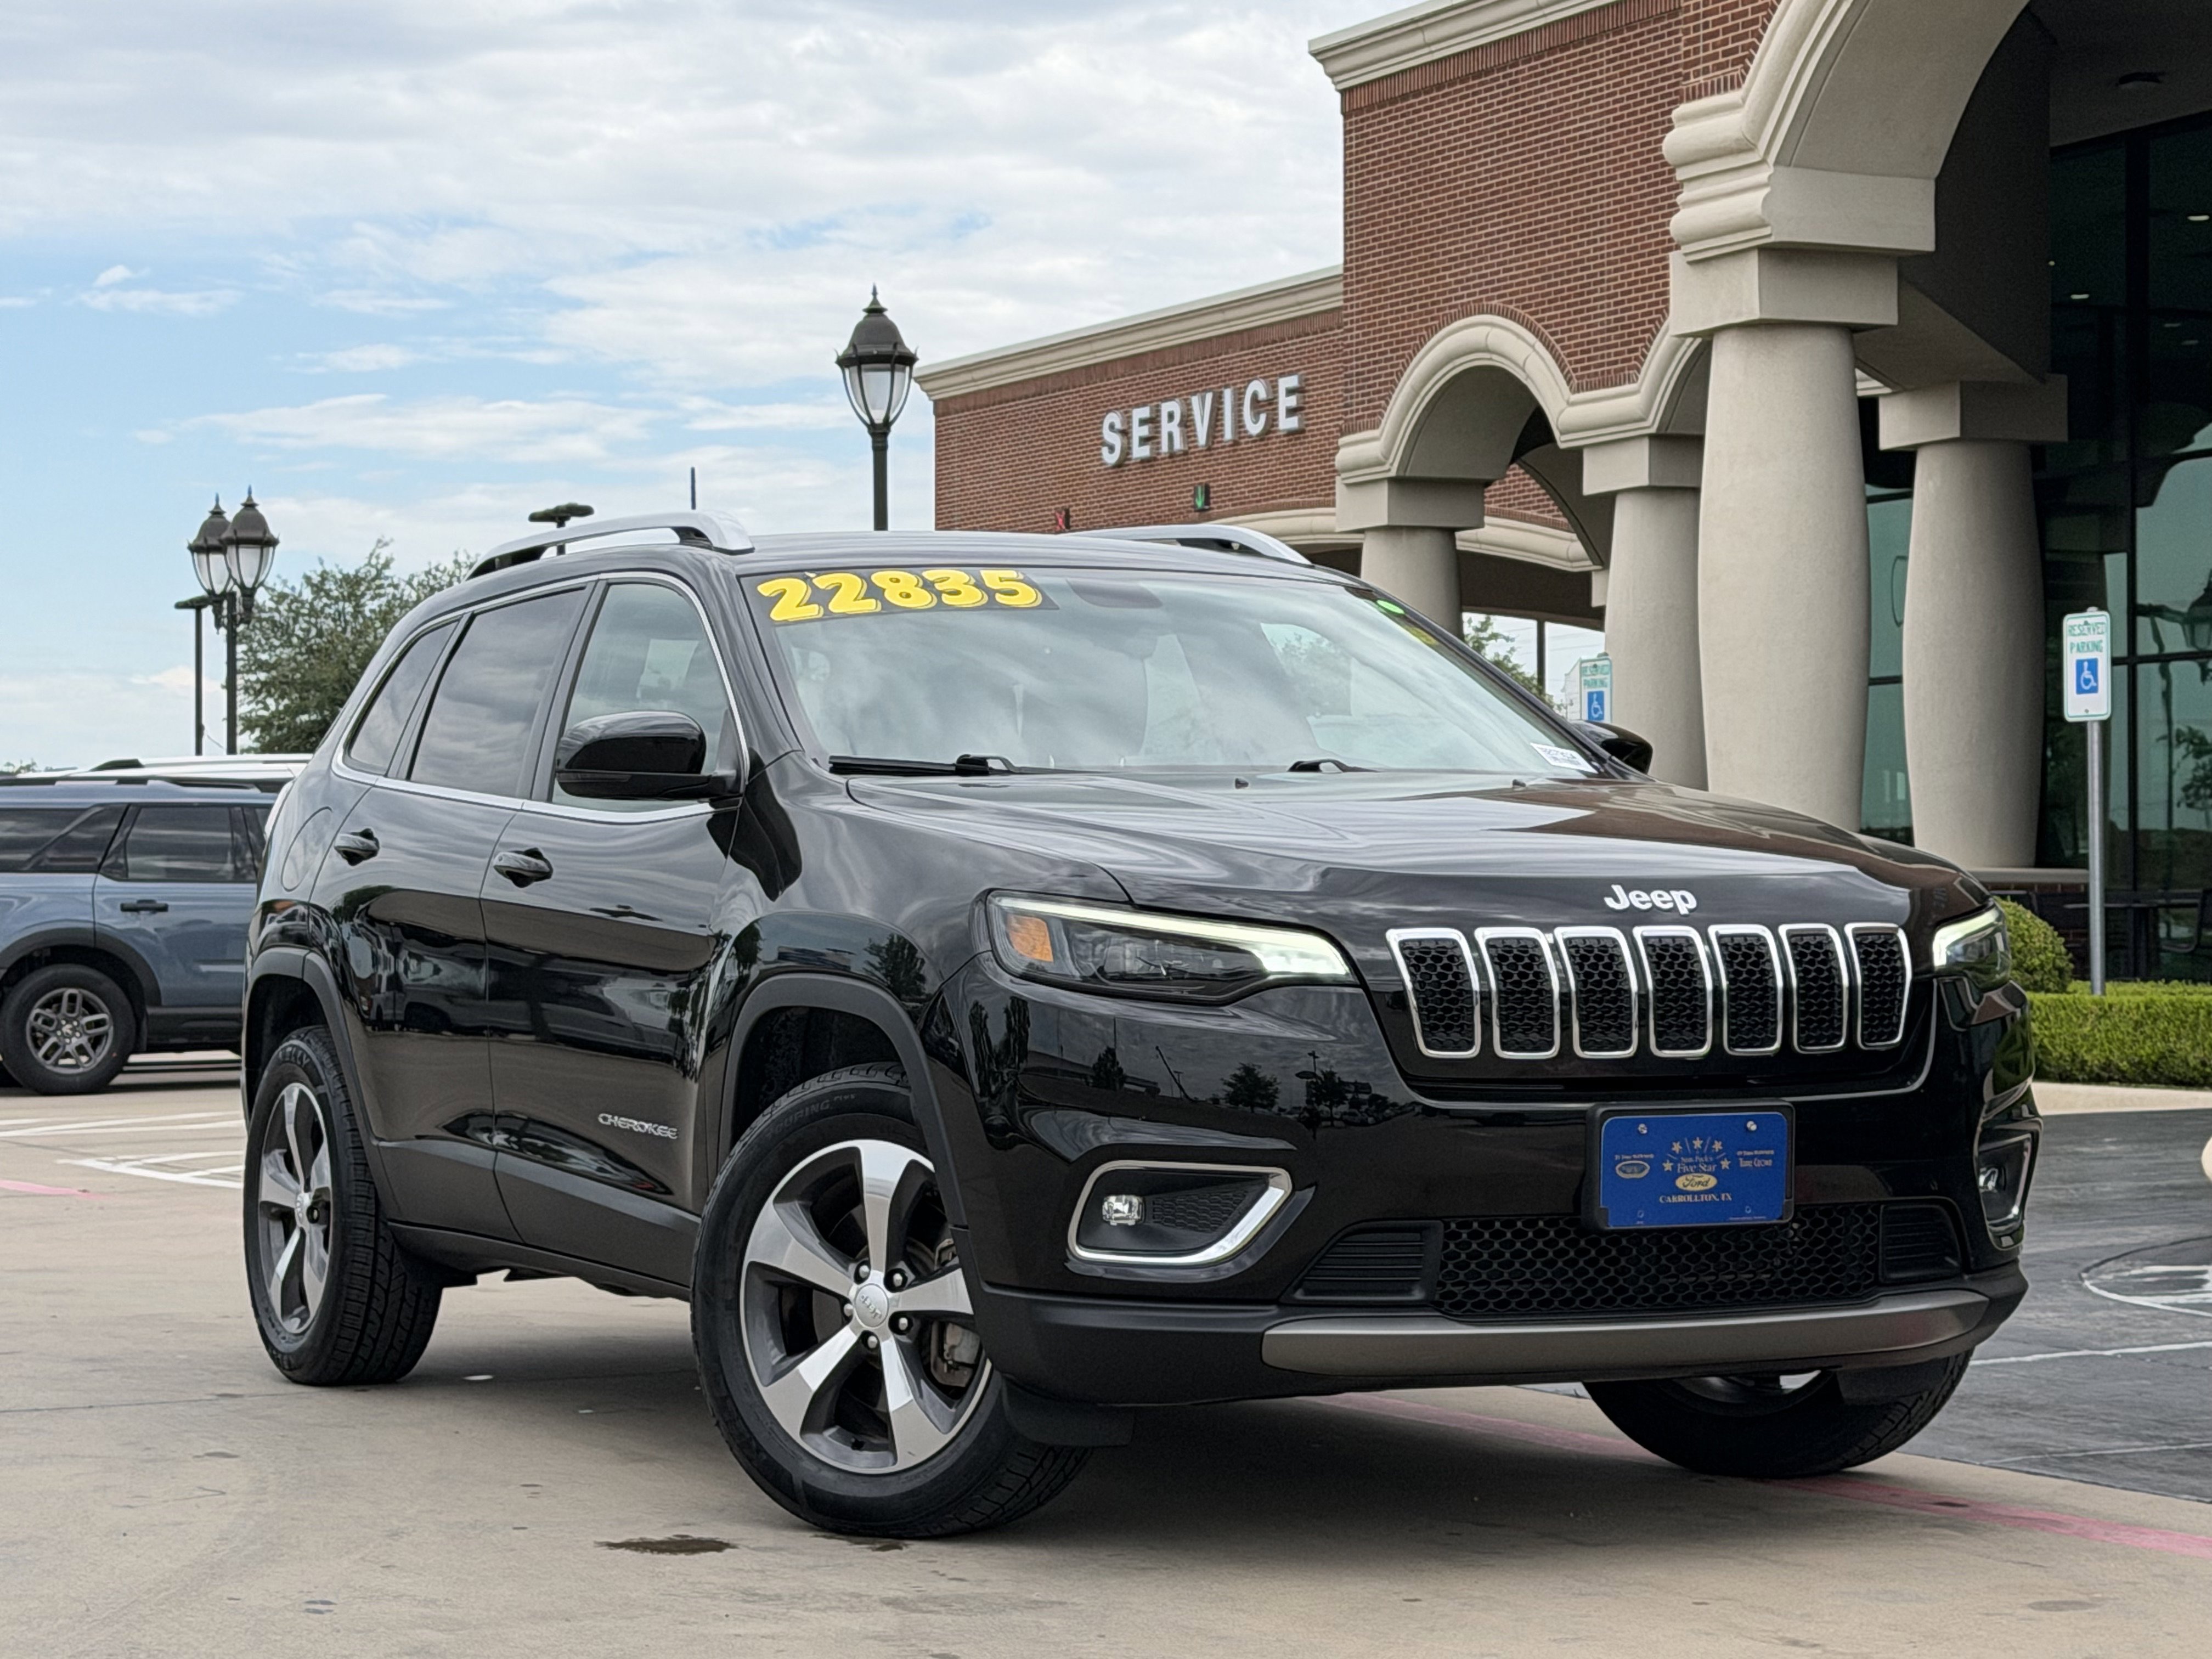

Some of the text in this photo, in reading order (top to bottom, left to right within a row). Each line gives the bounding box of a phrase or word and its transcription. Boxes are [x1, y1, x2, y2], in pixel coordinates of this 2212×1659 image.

[1101, 373, 1305, 467] SERVICE
[757, 569, 1042, 621] 22835
[2068, 622, 2105, 636] RESERVED
[2070, 640, 2103, 653] PARKING
[1604, 884, 1697, 916] Jeep
[598, 1113, 678, 1139] CHEROKEE
[1683, 1177, 1710, 1188] Ford
[1721, 1193, 1732, 1201] TX
